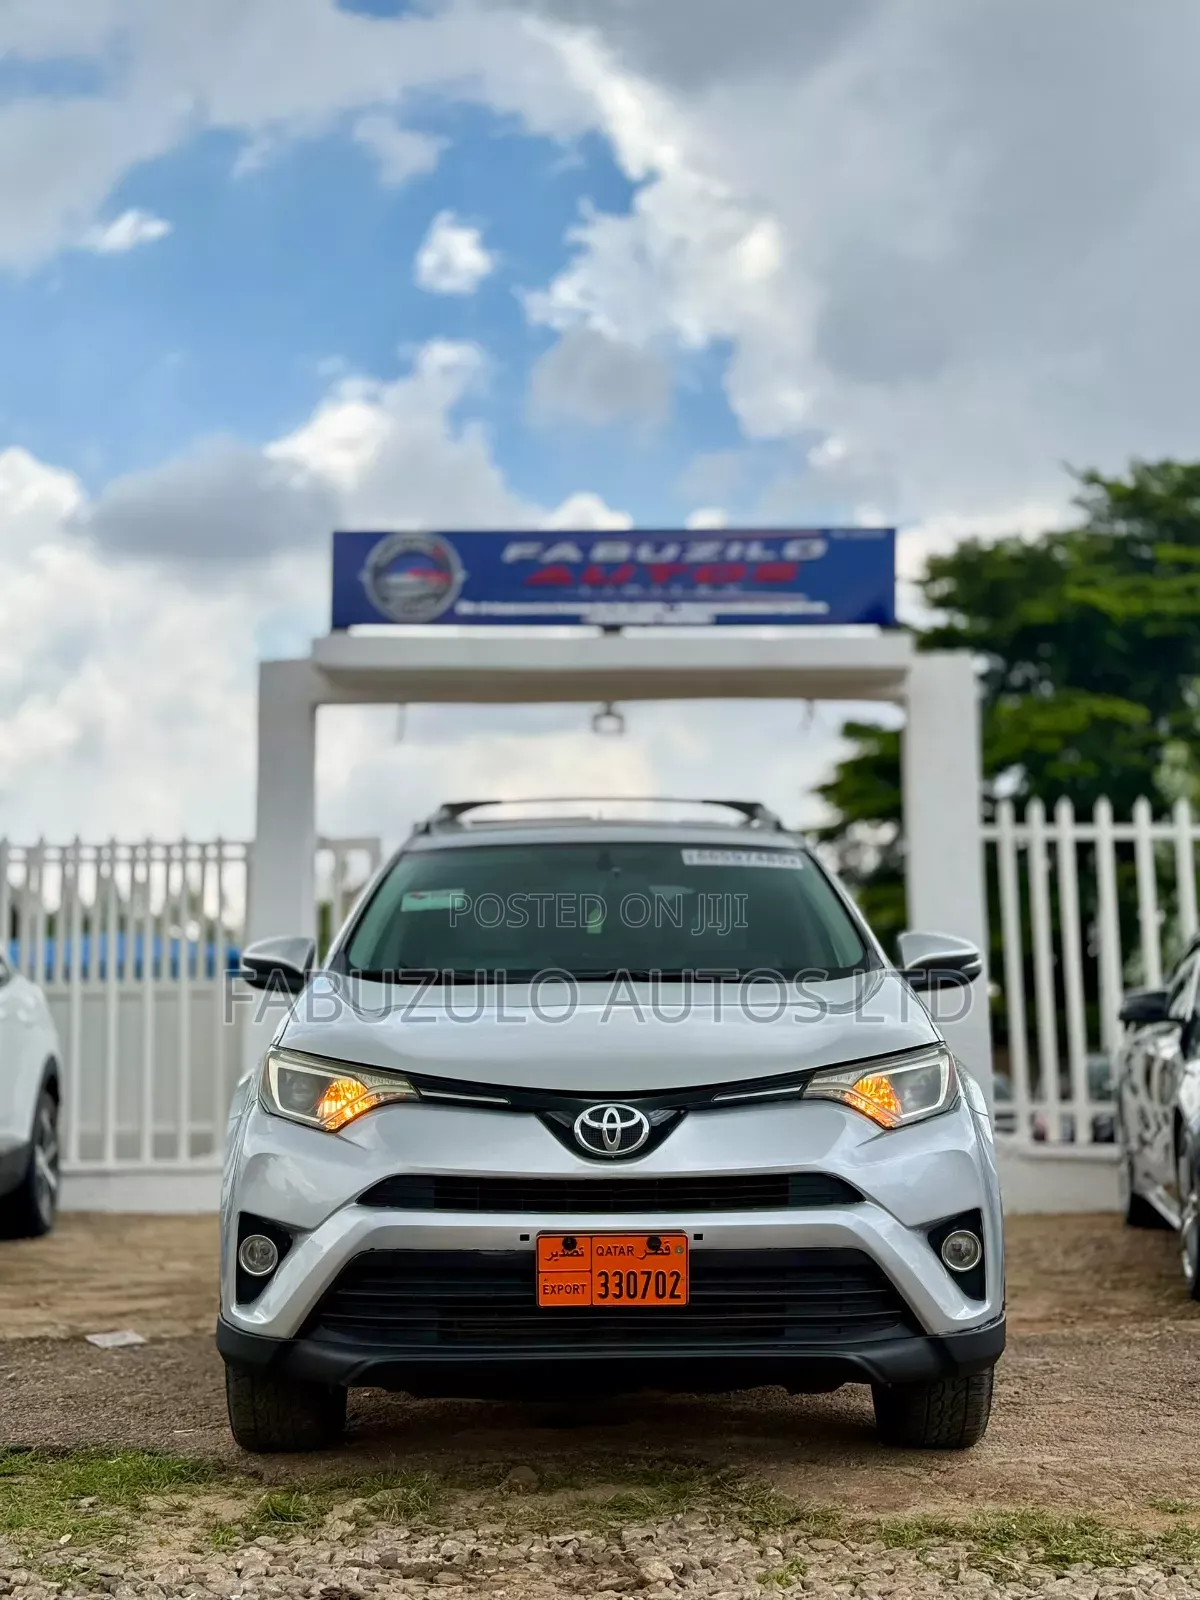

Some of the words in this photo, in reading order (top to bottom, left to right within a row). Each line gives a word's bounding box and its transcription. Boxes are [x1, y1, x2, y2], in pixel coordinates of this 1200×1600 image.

[596, 1244, 635, 1257] QATAR
[542, 1283, 588, 1295] EXPORT
[596, 1269, 682, 1300] 330702
